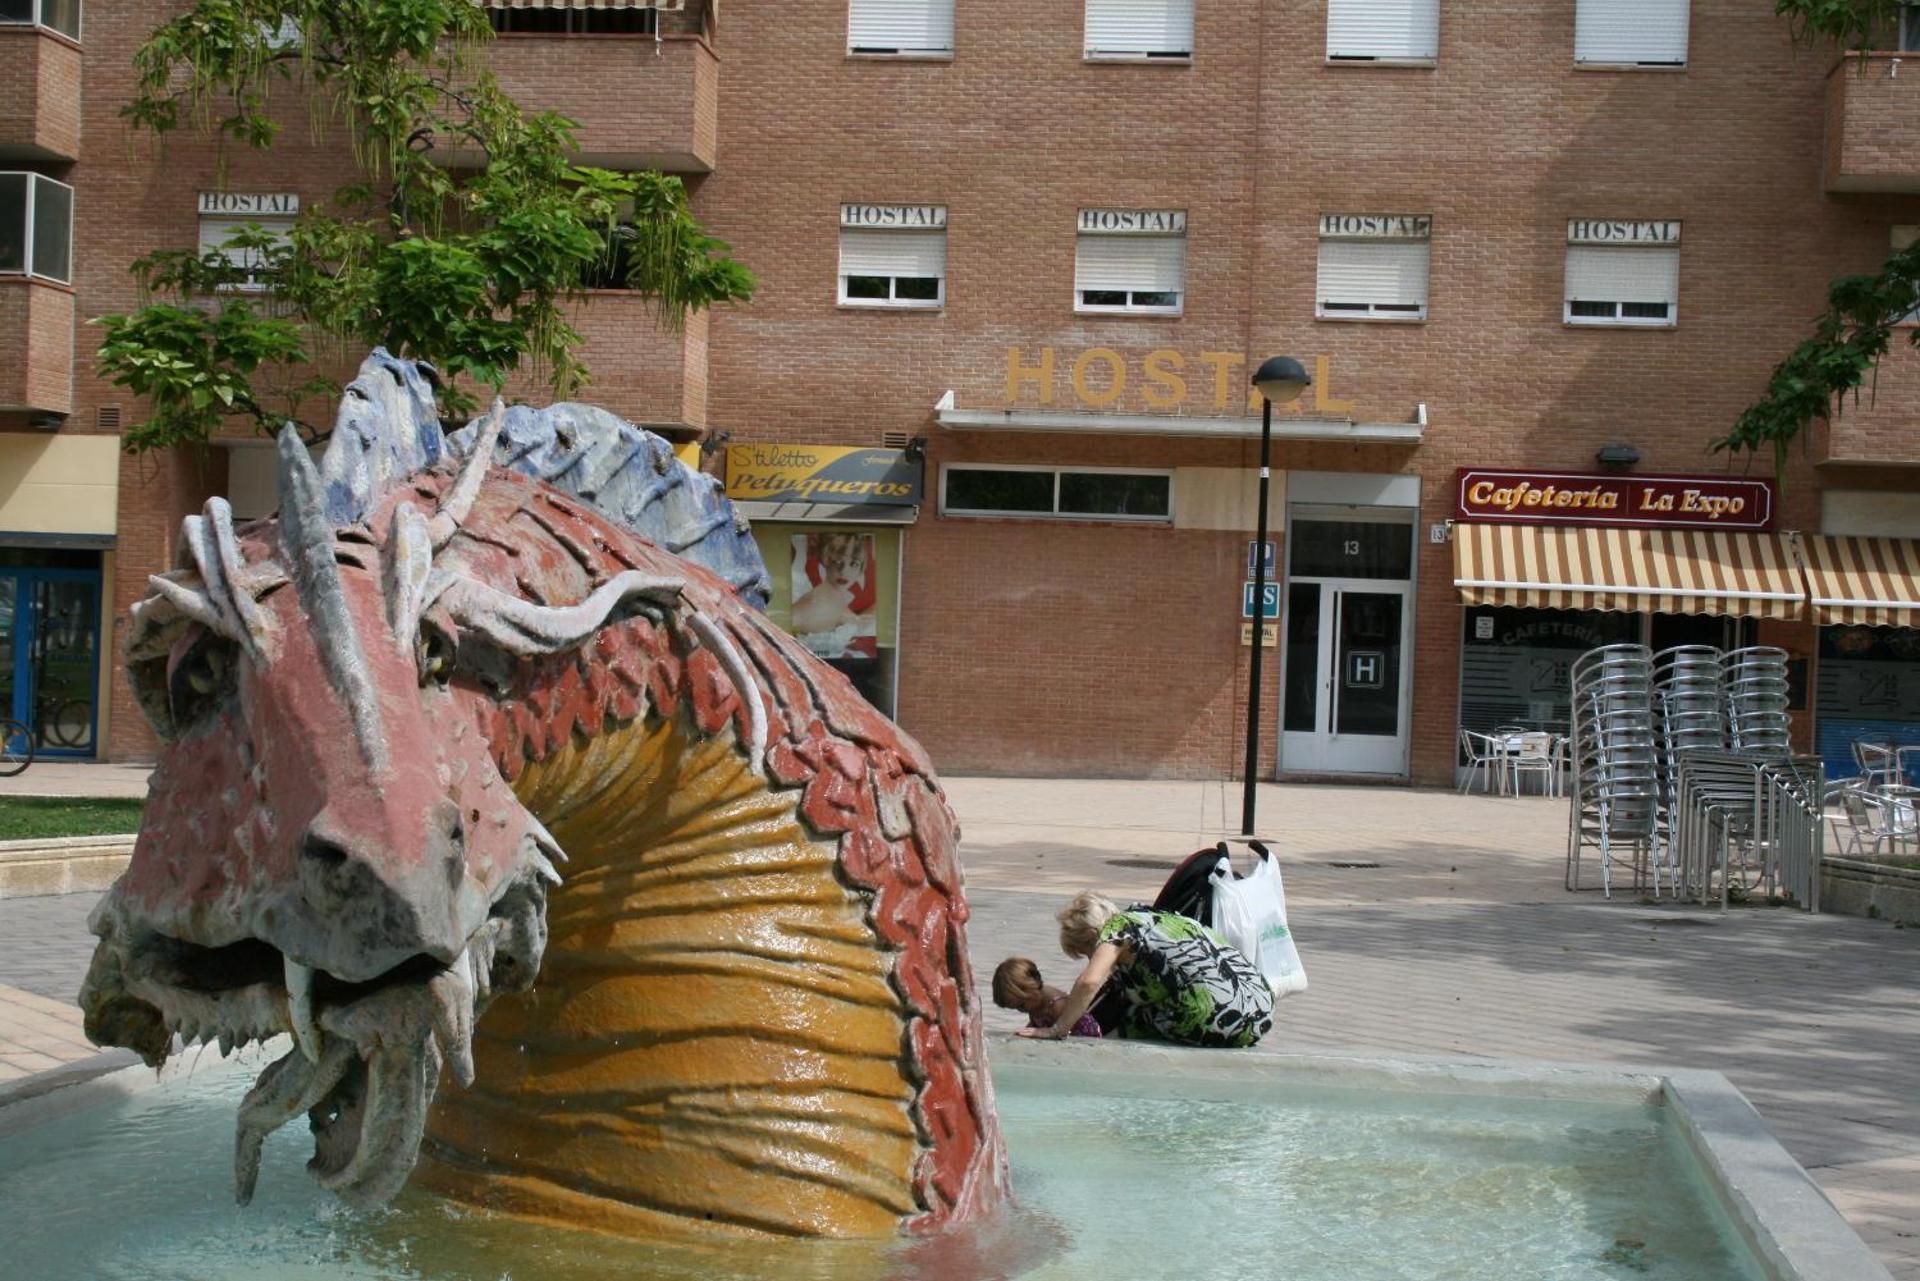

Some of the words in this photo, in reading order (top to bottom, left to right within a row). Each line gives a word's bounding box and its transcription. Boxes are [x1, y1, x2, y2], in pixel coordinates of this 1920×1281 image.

[204, 193, 297, 212] HOSTAL
[845, 206, 945, 226] HOSTAL
[1083, 211, 1183, 231] HOSTAL
[1323, 215, 1429, 235] HOSTAL
[1572, 220, 1677, 241] HOSTAL
[1006, 347, 1354, 412] HOSTL
[733, 444, 819, 468] Stiletto
[732, 471, 913, 499] Peluqueros
[1468, 481, 1618, 512] Cafetería
[1640, 488, 1674, 512] La
[1679, 489, 1745, 519] Expo
[1344, 540, 1360, 556] 13
[1355, 657, 1375, 682] H
